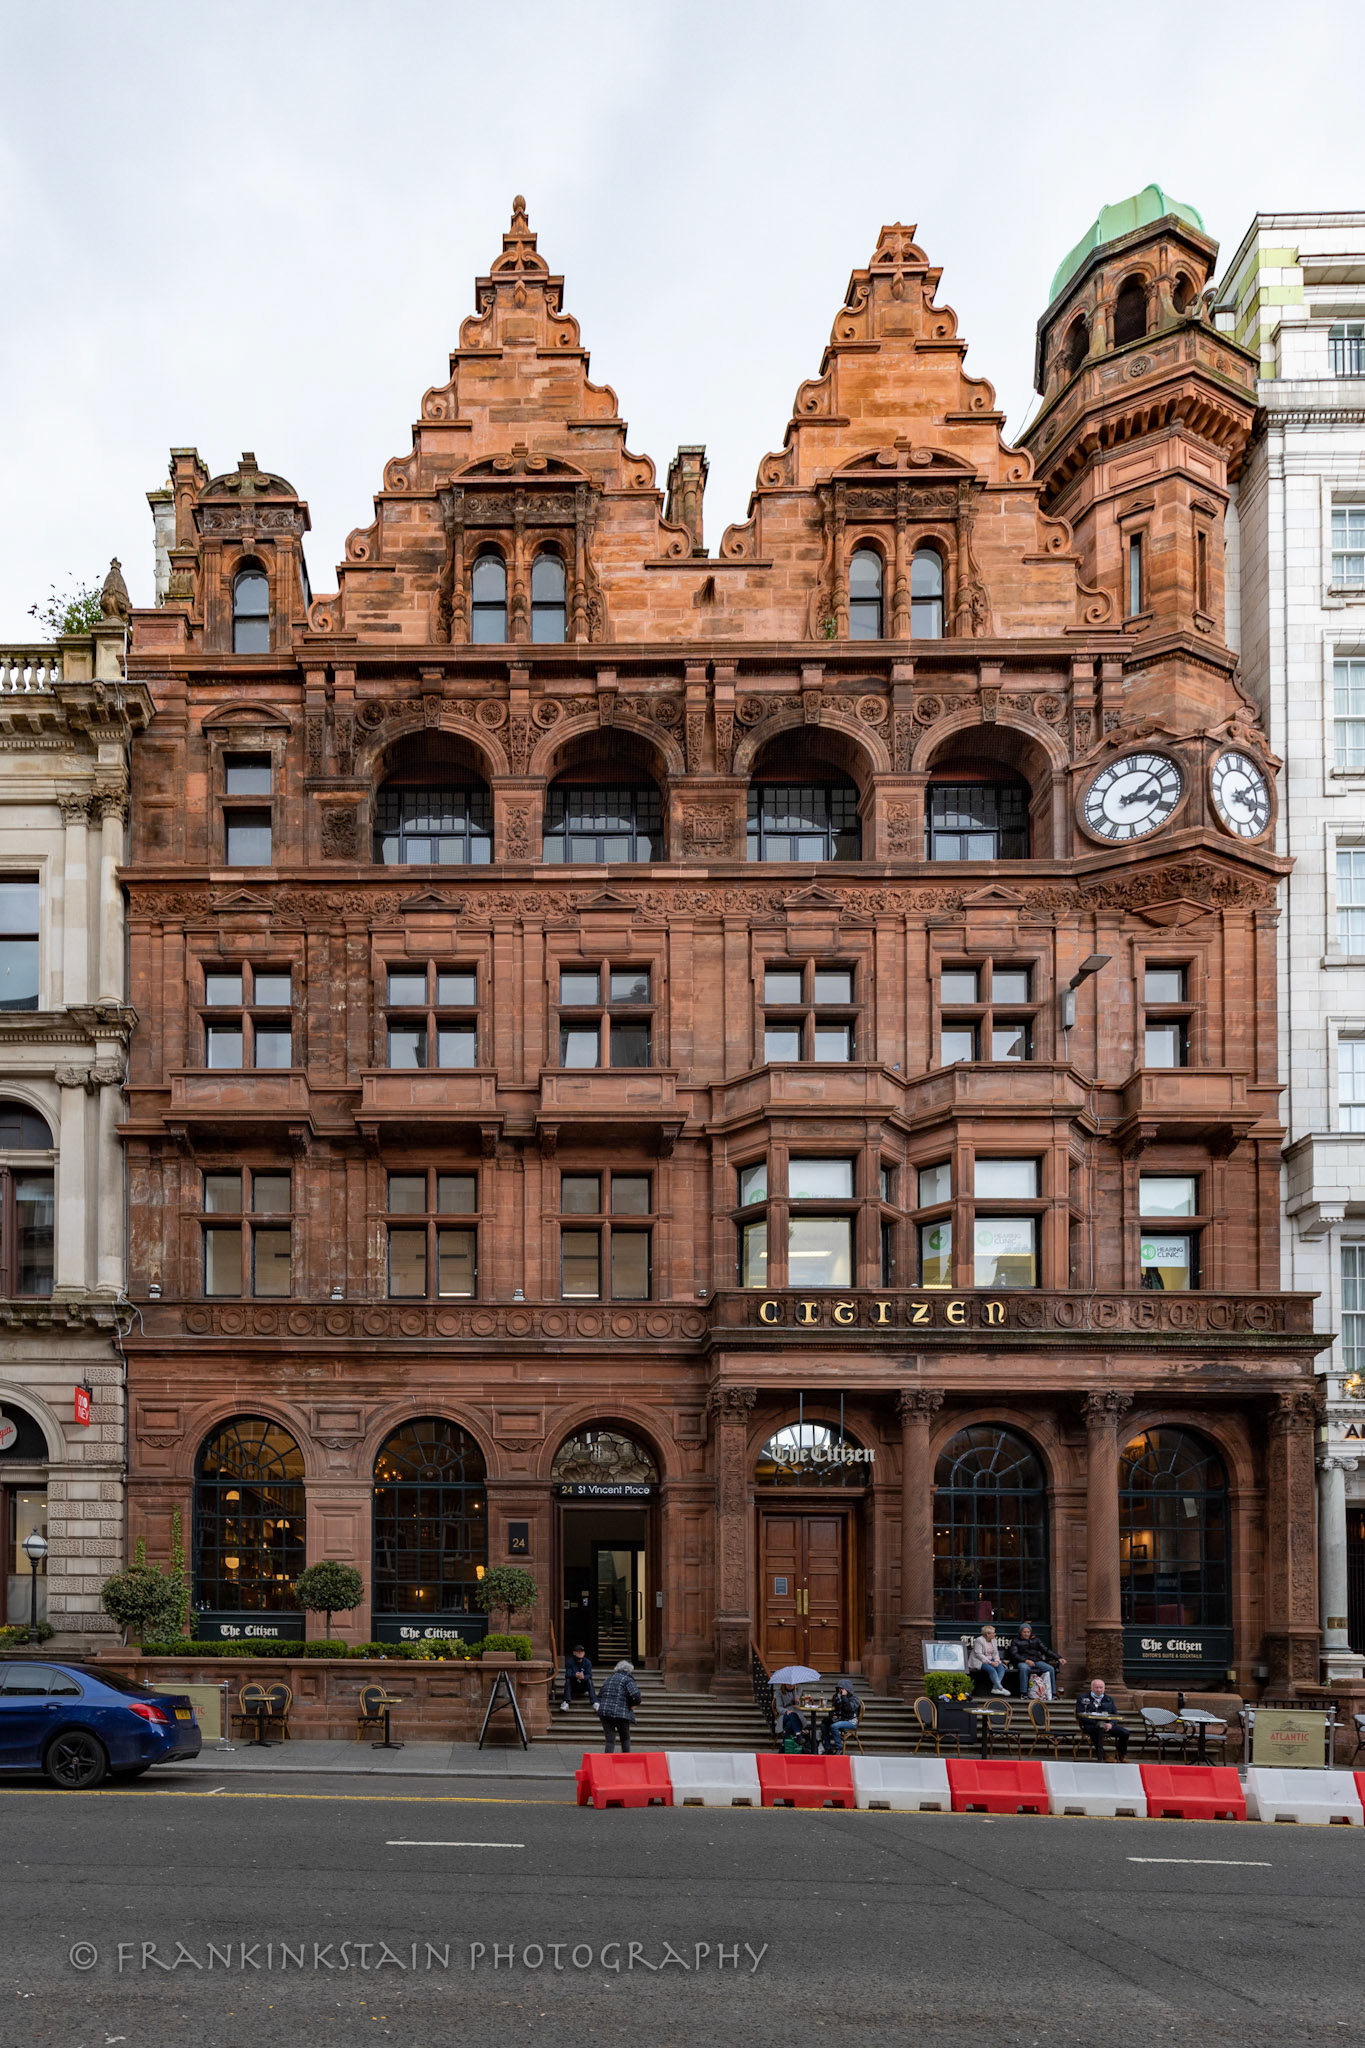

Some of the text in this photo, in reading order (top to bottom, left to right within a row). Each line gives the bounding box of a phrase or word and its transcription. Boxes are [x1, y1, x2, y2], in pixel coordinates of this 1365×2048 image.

[759, 1300, 1005, 1325] CITIZEN
[771, 1441, 876, 1467] The Citizen
[562, 1485, 650, 1495] 24 St Vincent Place
[512, 1537, 526, 1548] 24
[220, 1624, 279, 1638] The Citizen
[400, 1626, 459, 1641] The Citizen
[1141, 1638, 1203, 1653] The Citizen
[1270, 1732, 1309, 1741] ATLANTIC
